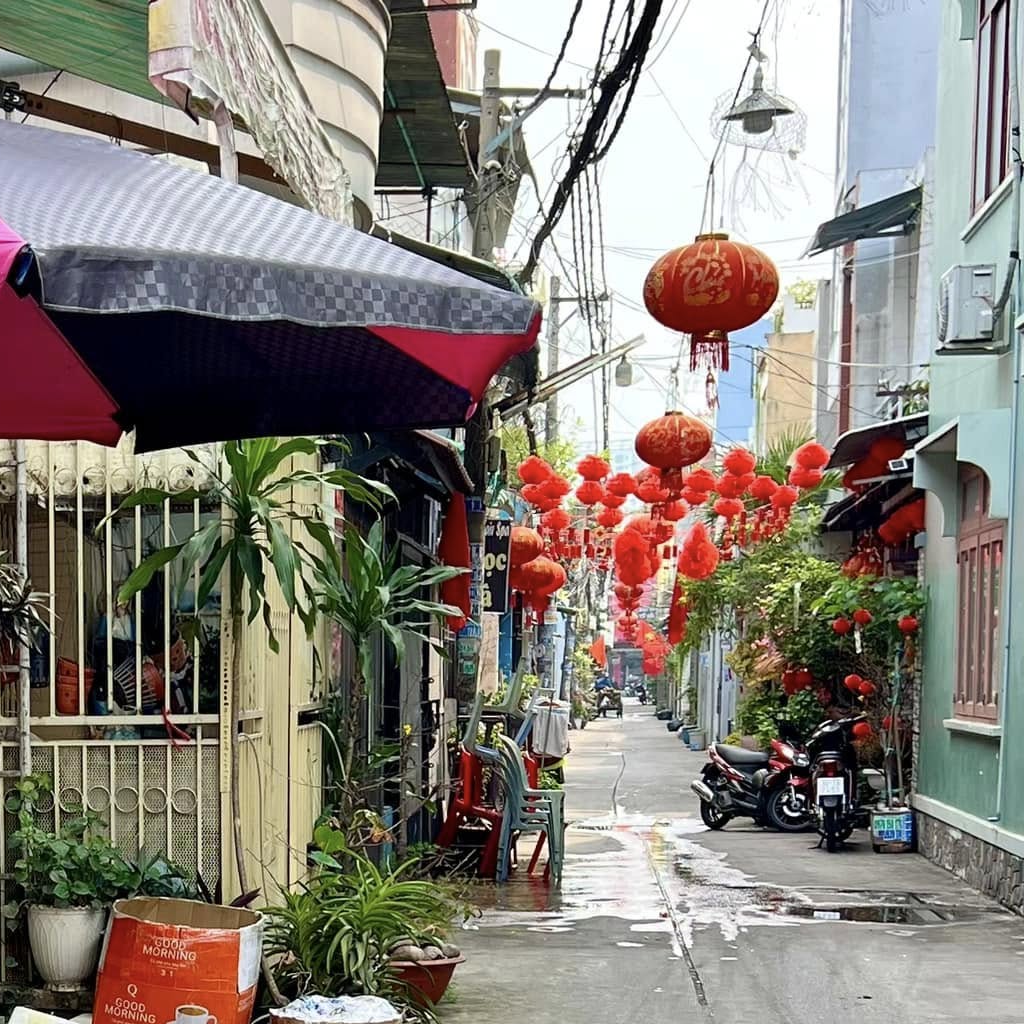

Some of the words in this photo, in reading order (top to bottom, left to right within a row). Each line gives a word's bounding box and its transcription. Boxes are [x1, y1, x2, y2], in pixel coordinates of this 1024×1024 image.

[484, 553, 507, 577] ọc
[155, 937, 186, 951] GOOD
[142, 944, 197, 961] MORNING
[127, 984, 138, 998] Q
[115, 997, 146, 1013] GOOD
[104, 1004, 156, 1024] MORNING
